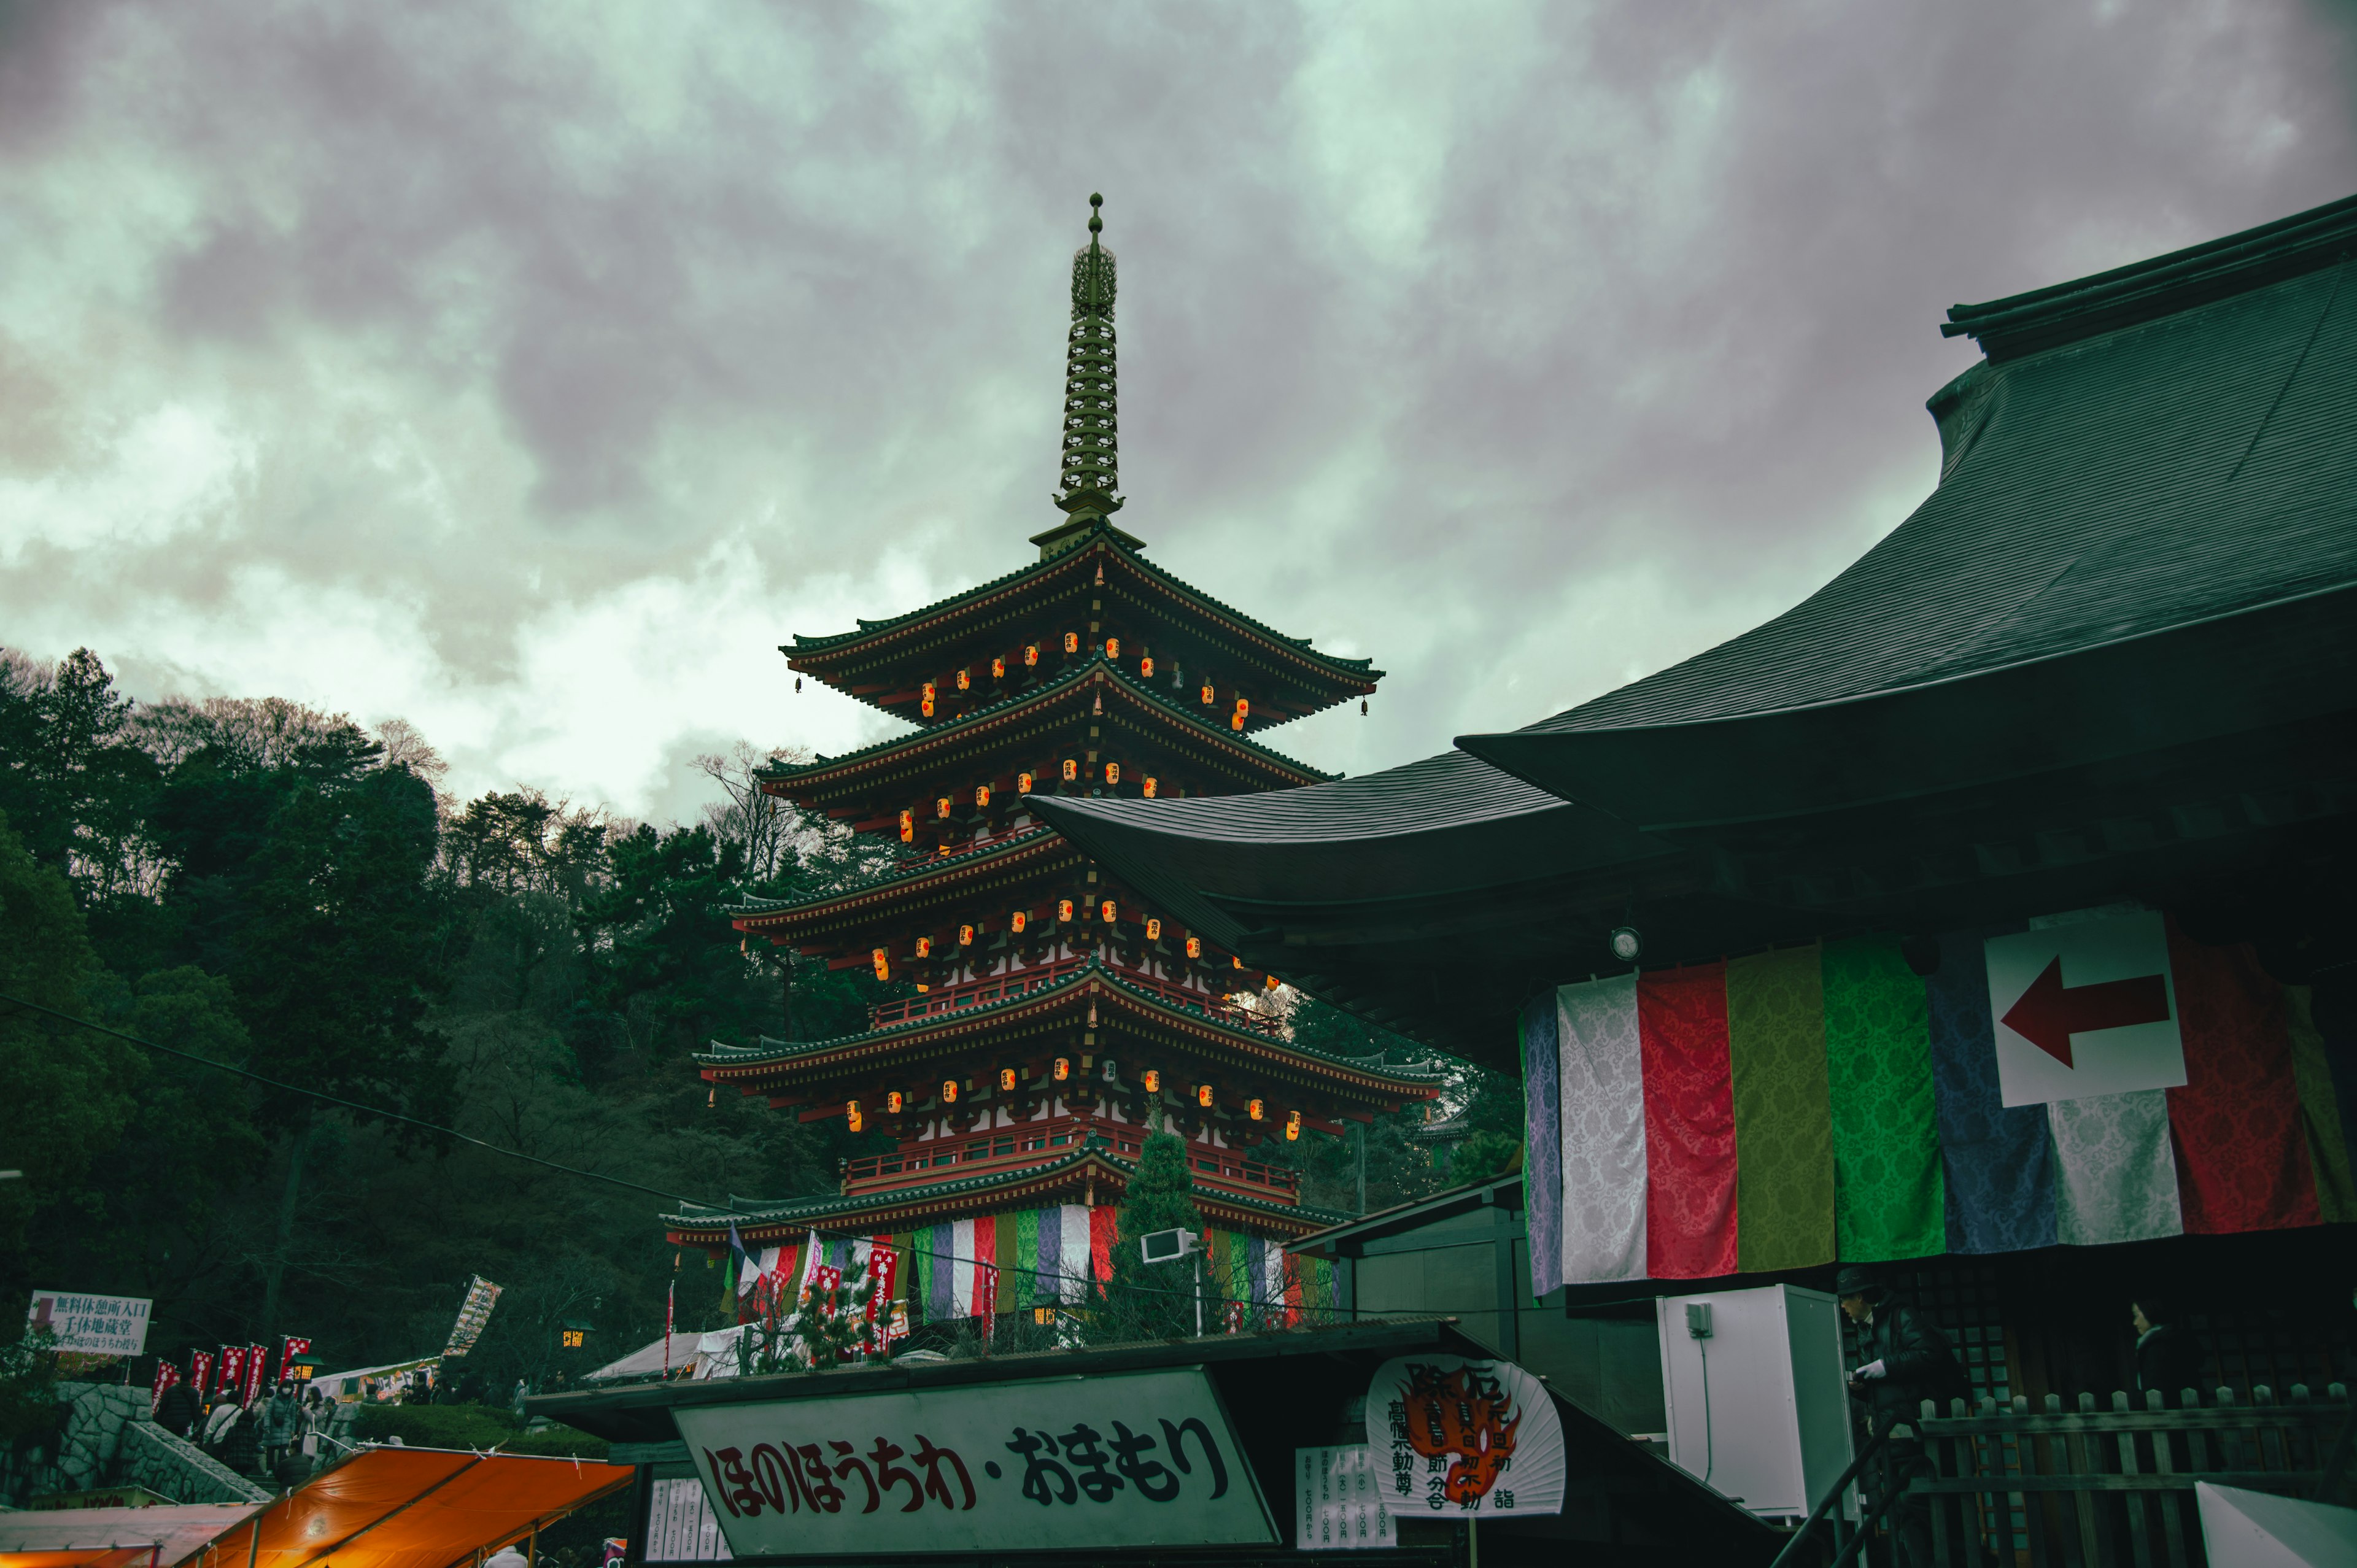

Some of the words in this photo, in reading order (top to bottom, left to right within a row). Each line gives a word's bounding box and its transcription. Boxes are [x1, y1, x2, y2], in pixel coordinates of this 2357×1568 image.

[55, 1296, 147, 1317] 無料休憩所入口
[64, 1316, 133, 1336] 千体地蔵堂
[1488, 1404, 1514, 1508] 元旦初詣
